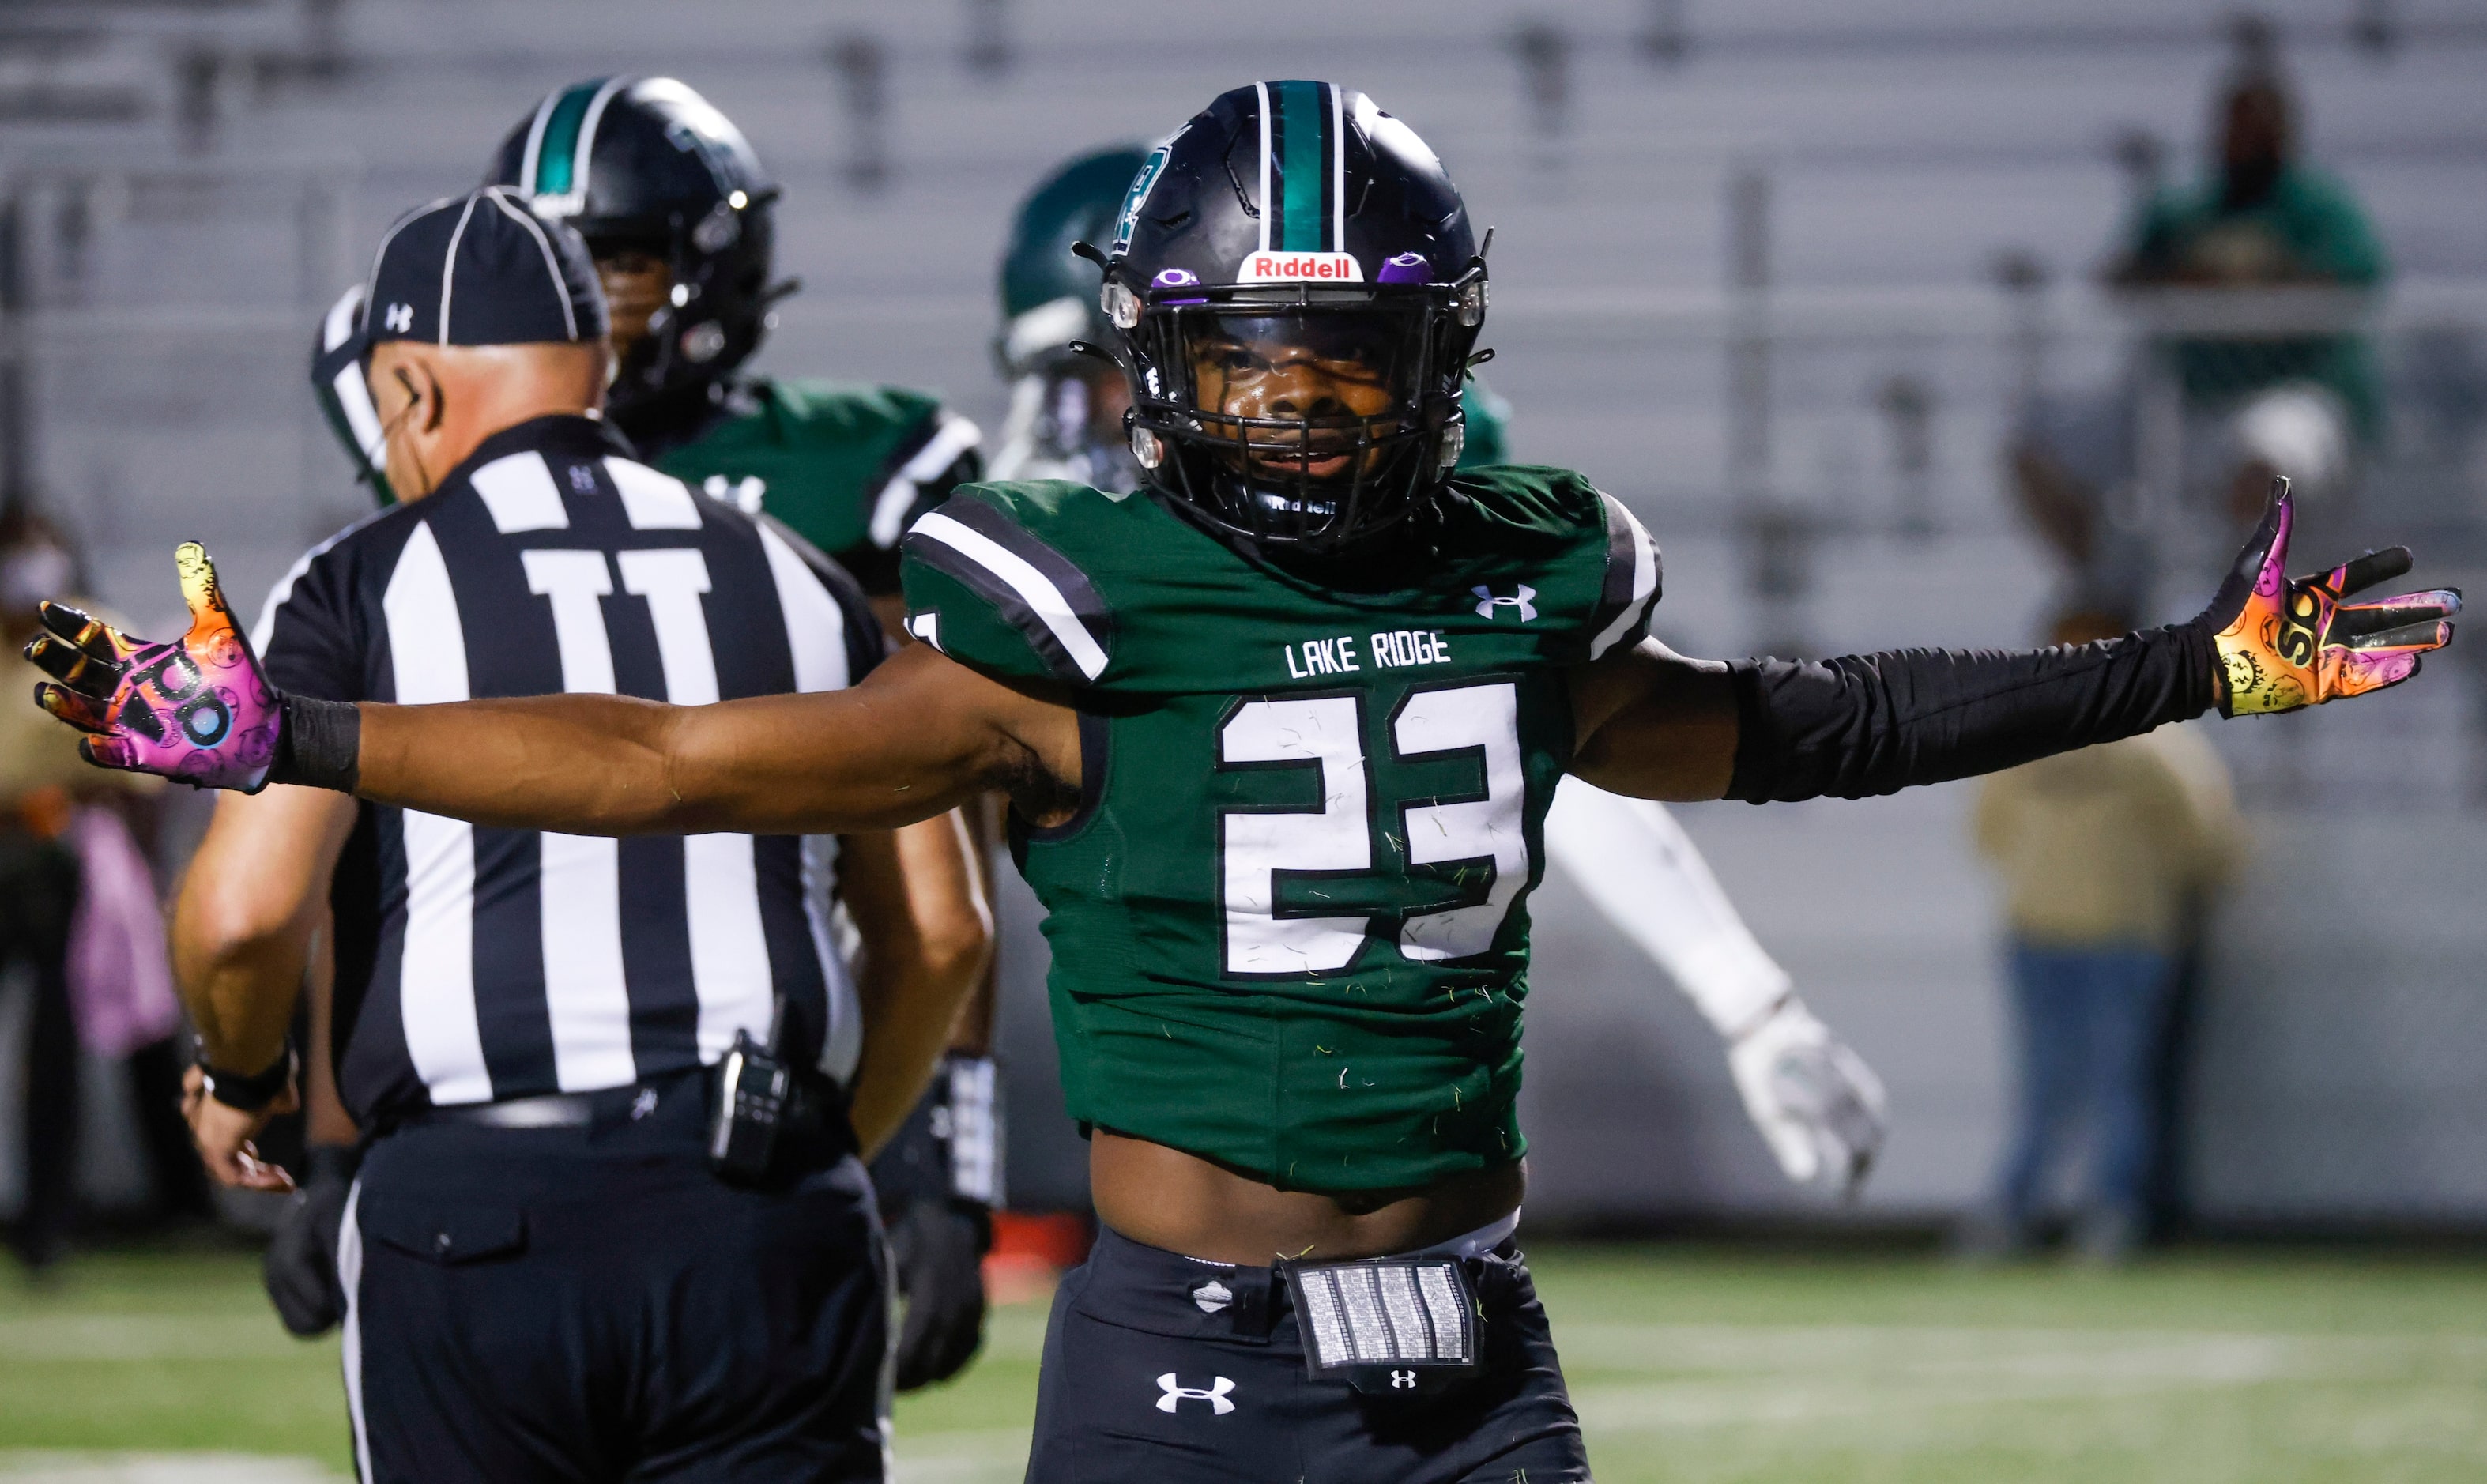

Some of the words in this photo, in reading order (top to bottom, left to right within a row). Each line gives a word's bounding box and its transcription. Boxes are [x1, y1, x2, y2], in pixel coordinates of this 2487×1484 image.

[1255, 258, 1350, 278] Riddell
[1285, 636, 1361, 680] LAKE
[1371, 630, 1452, 669] RIDGE
[1220, 681, 1531, 974] 23
